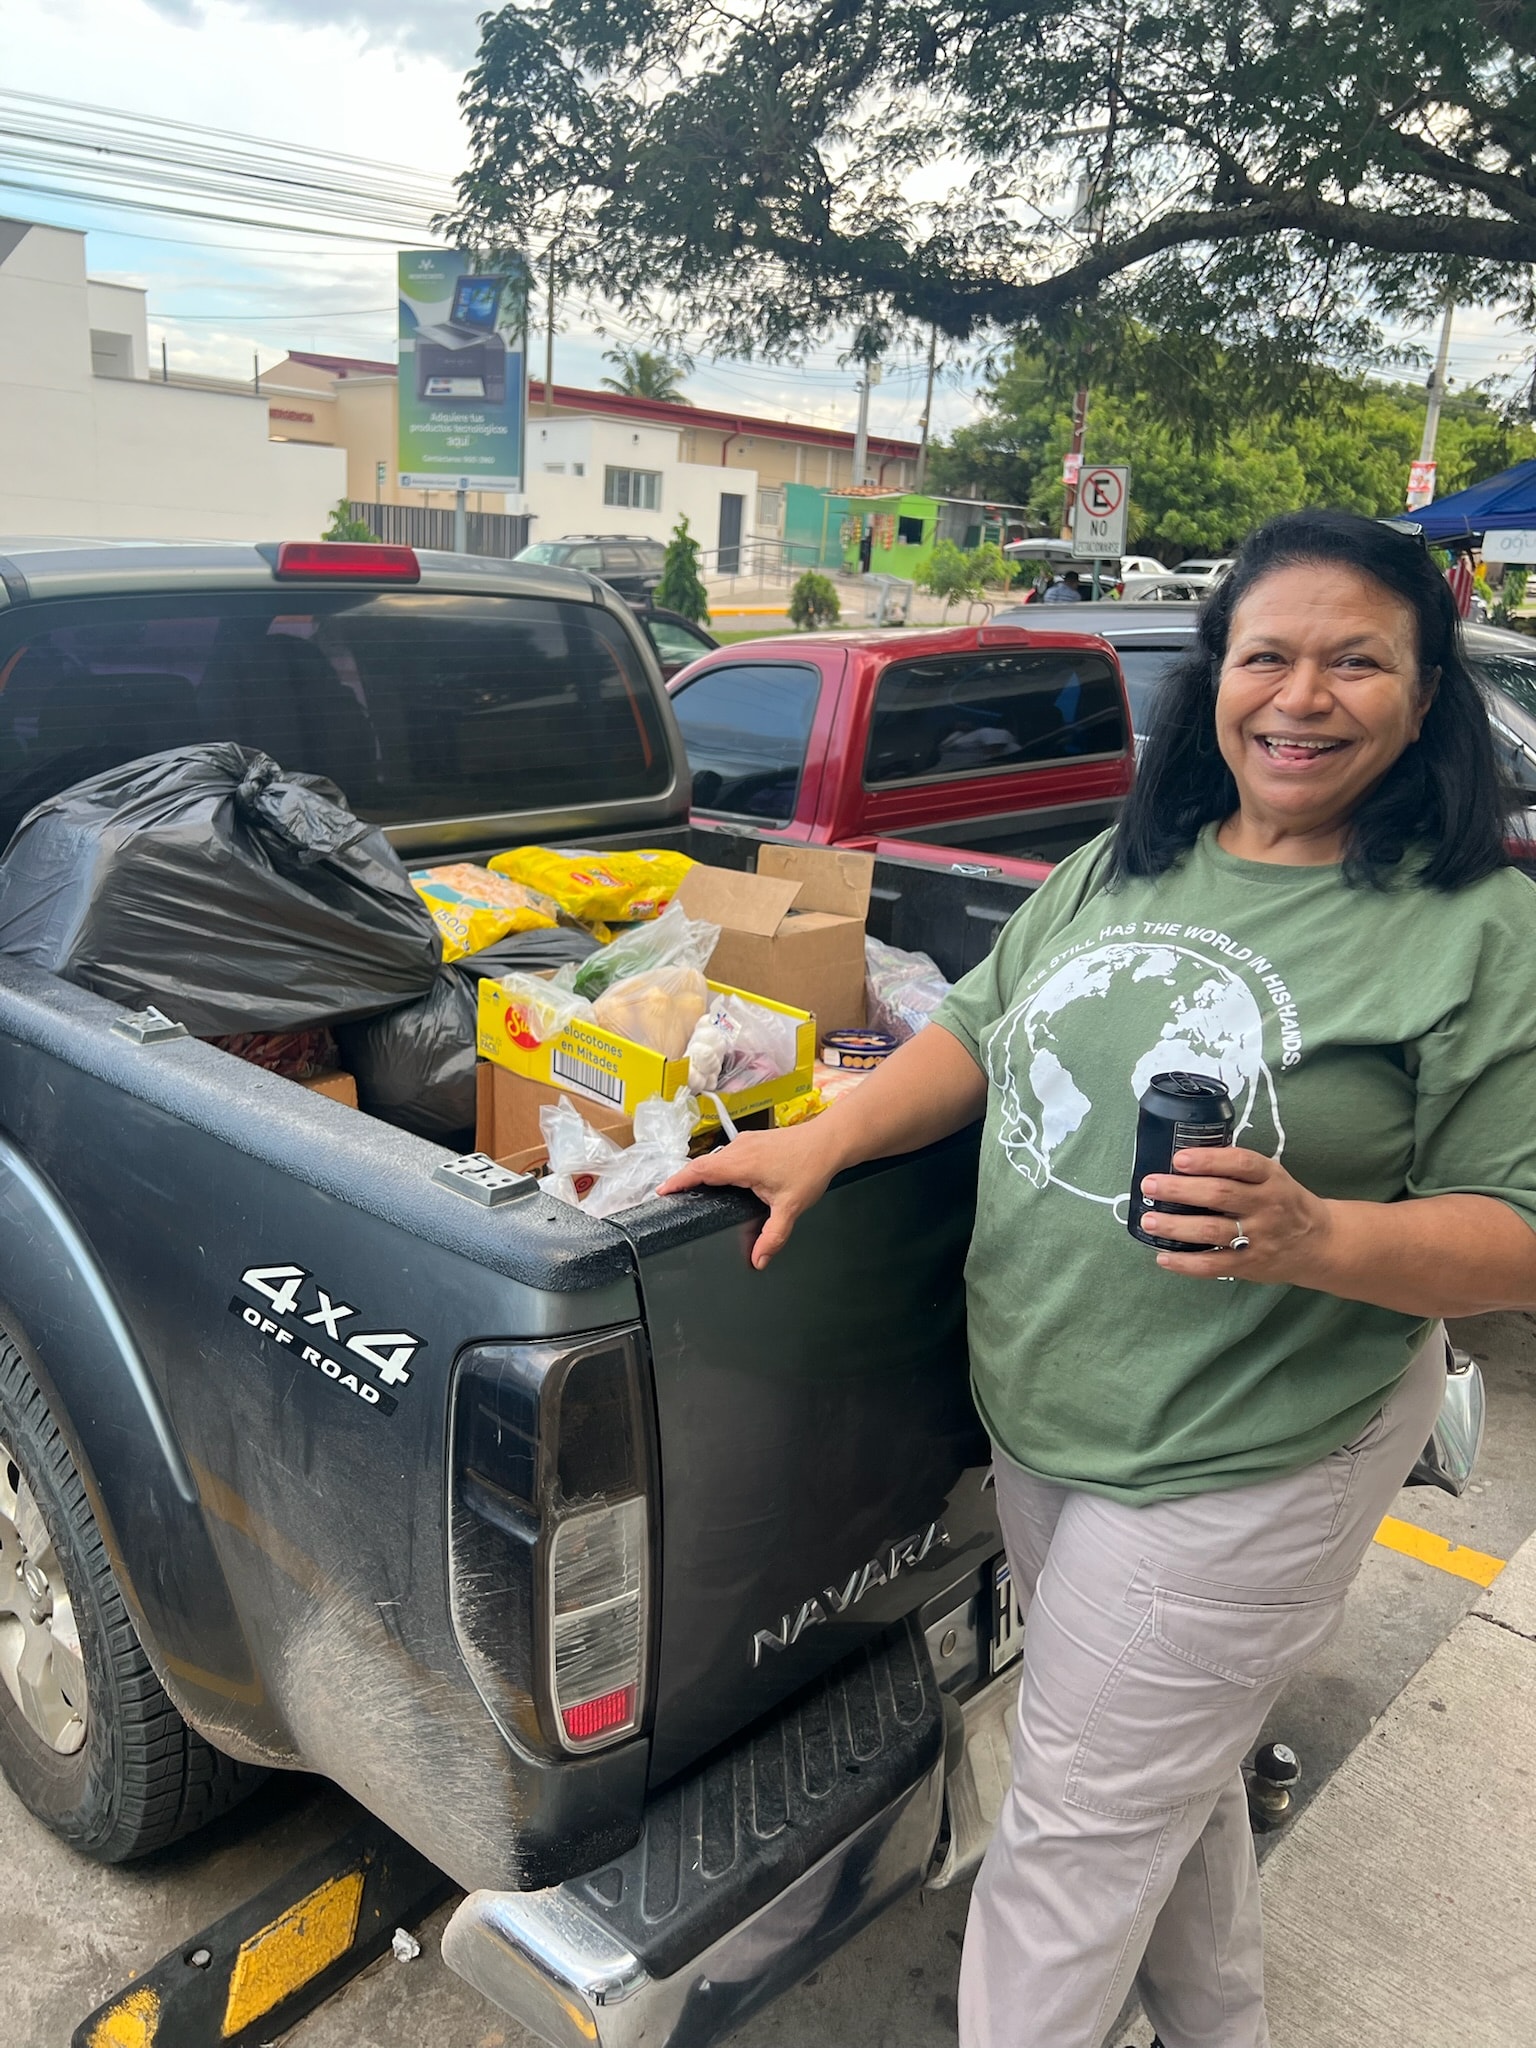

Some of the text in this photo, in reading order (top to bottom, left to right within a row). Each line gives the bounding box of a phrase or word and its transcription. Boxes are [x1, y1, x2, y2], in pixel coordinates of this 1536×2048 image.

[409, 423, 452, 434] productos
[470, 413, 485, 423] tus
[1090, 520, 1108, 537] NO
[1050, 939, 1096, 968] STILL
[1099, 922, 1137, 941] HAS
[1143, 921, 1182, 936] THE
[1183, 926, 1252, 961] WORLD
[1247, 956, 1272, 975] IN
[1262, 973, 1291, 1005] HIS
[561, 1040, 618, 1073] en Mitades
[564, 1025, 623, 1058] elocotones
[242, 1306, 381, 1405] OFF ROAD
[752, 1519, 950, 1669] NAVARA
